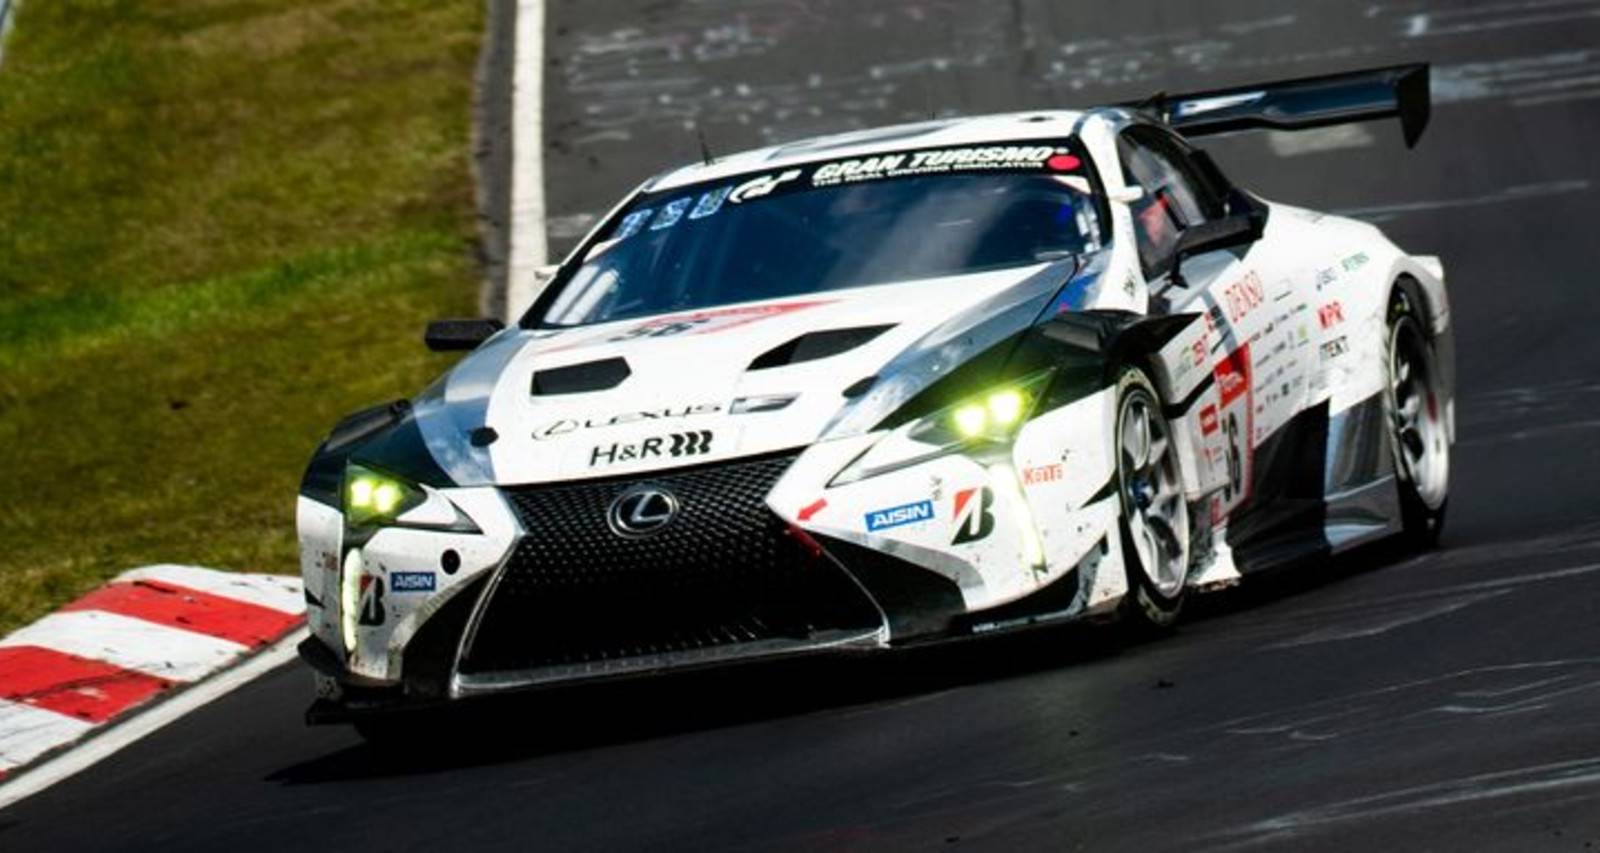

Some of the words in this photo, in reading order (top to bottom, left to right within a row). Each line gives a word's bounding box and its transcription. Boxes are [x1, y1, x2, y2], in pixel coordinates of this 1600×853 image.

[812, 153, 906, 181] GRAN
[909, 146, 1053, 169] TURISMO
[812, 177, 842, 187] THE
[845, 171, 884, 184] REAL
[887, 166, 950, 177] DRIVING
[952, 160, 1045, 172] SIMULATOR
[1224, 270, 1265, 324] DENSO
[585, 404, 722, 429] LEXUS
[588, 437, 664, 467] H&R
[870, 503, 930, 529] AISIN
[394, 573, 434, 589] AISIN
